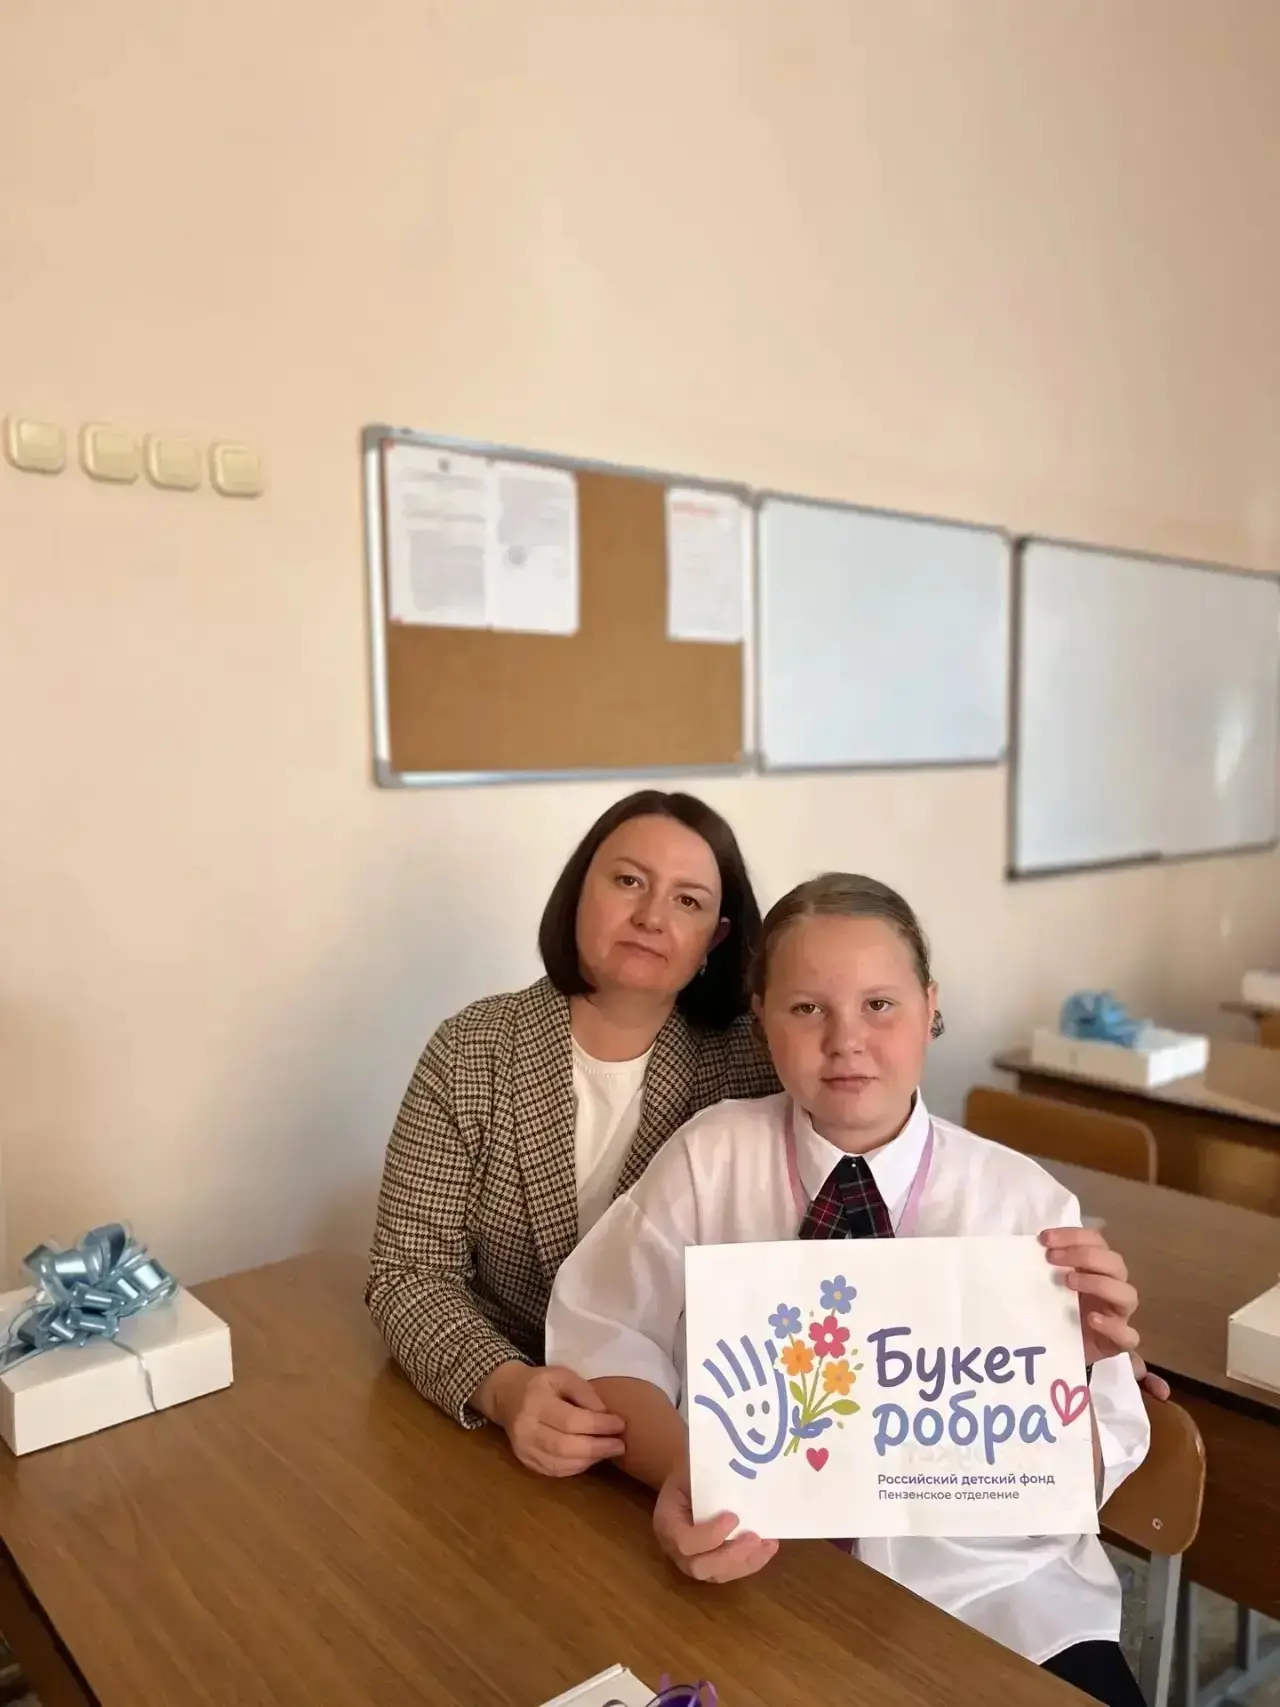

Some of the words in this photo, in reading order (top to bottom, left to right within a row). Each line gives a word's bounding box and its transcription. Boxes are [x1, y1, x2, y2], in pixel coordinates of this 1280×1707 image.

[867, 1326, 1047, 1402] Букет
[877, 1472, 958, 1486] Российский
[961, 1472, 1016, 1487] детский
[1019, 1472, 1056, 1487] фонд
[878, 1489, 952, 1501] Пензенское
[954, 1490, 1020, 1501] отделение
